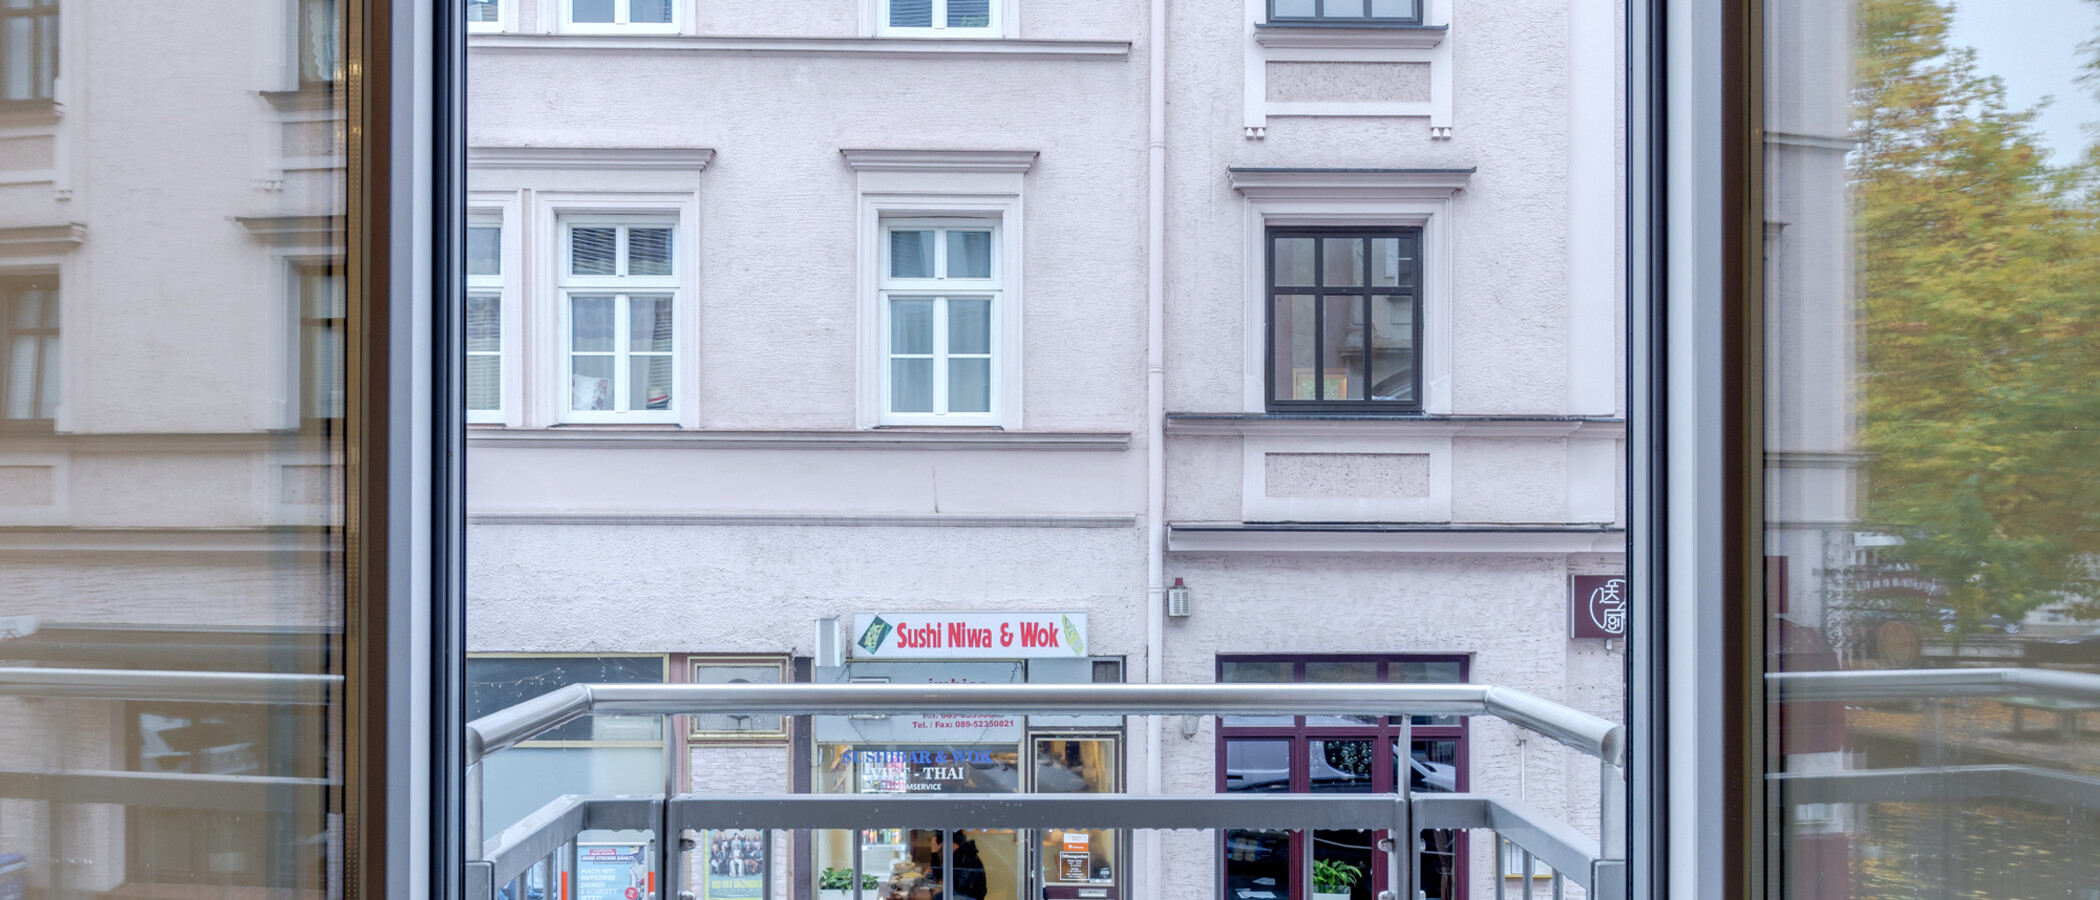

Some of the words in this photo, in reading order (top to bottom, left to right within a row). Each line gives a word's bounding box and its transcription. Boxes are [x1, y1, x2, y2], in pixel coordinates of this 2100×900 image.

[896, 622, 942, 648] Sushi
[948, 622, 992, 648] Niwa
[1000, 622, 1014, 647] &
[1020, 622, 1059, 648] Wok
[912, 721, 928, 729] Tel.
[955, 720, 1014, 728] 089-52350821
[842, 750, 932, 764] SUSHIBAR
[935, 750, 947, 764] &
[950, 750, 993, 764] WOK
[871, 767, 910, 780] VIET
[922, 767, 964, 780] THAI
